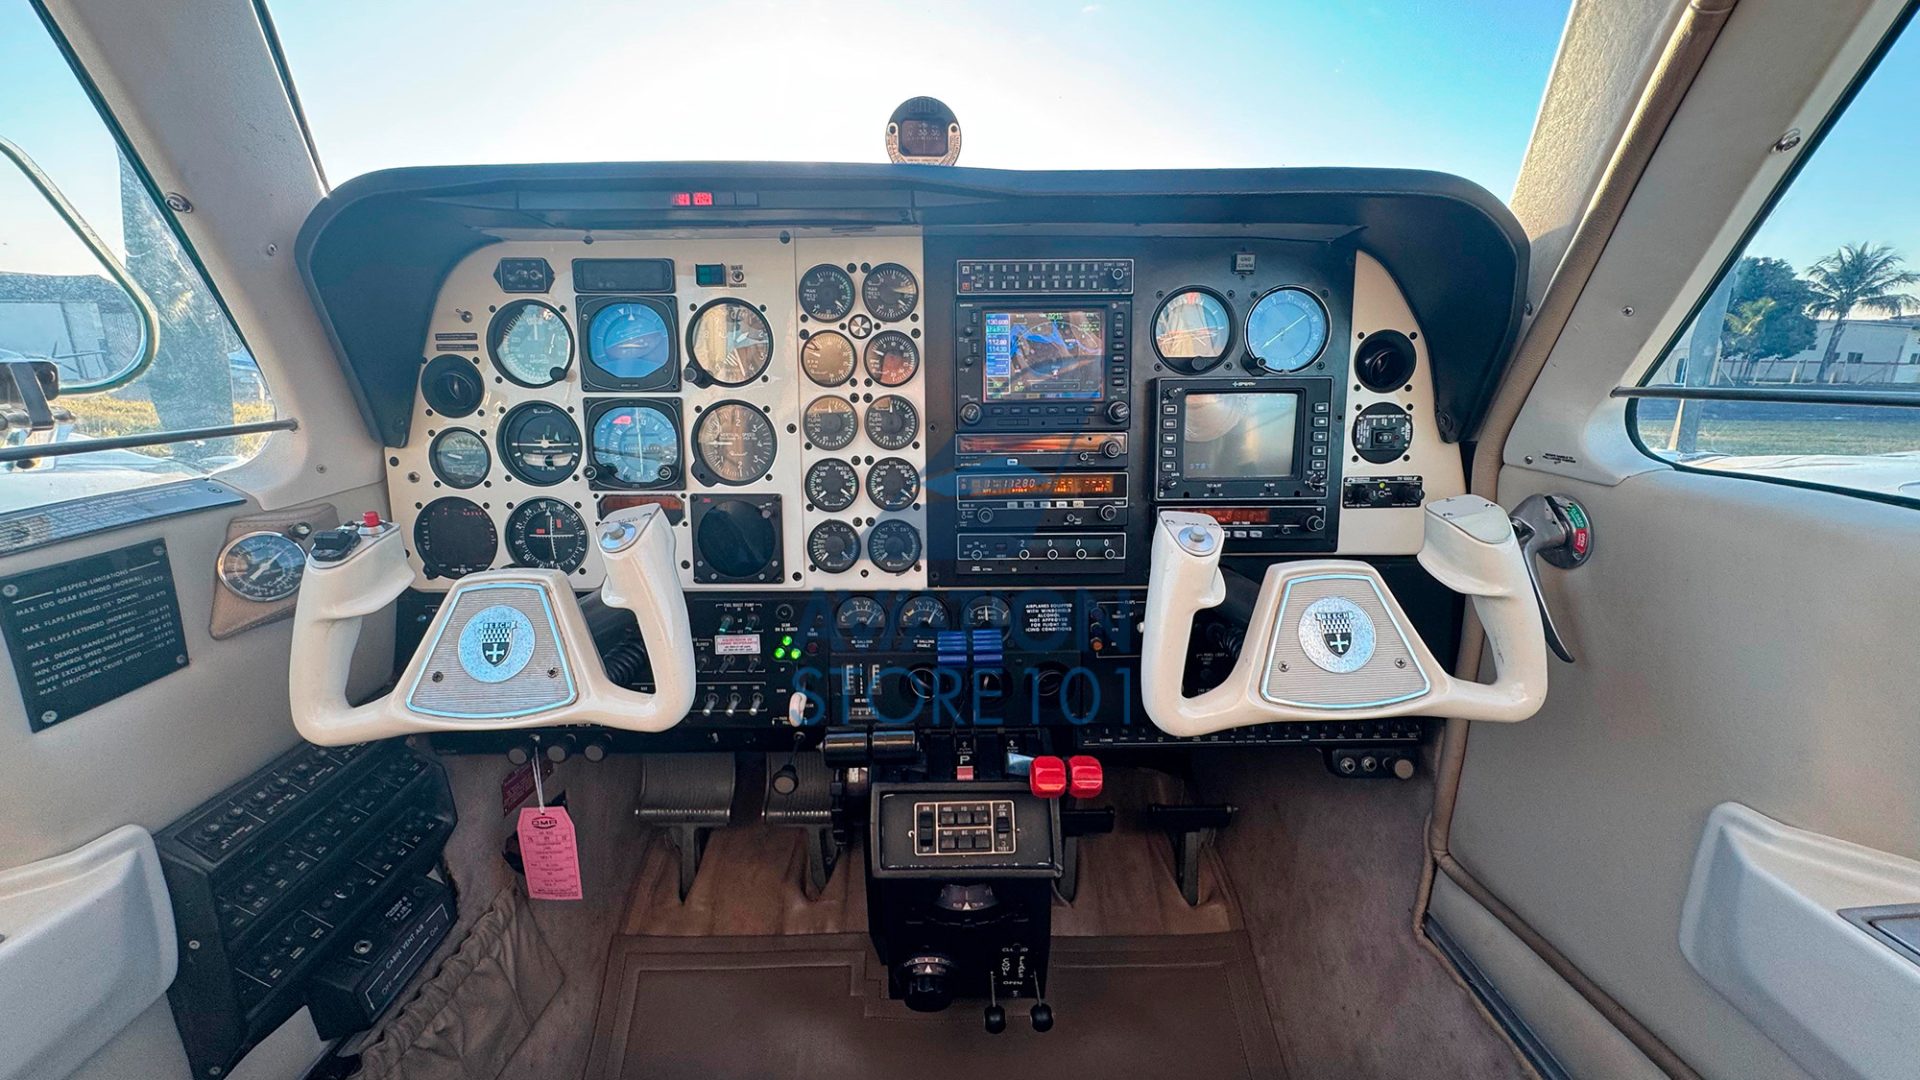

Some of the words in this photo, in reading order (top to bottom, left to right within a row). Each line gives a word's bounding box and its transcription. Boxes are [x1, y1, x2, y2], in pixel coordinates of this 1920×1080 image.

[56, 578, 88, 594] AIRSPEED
[90, 569, 129, 584] LIMITATIONS
[80, 584, 111, 598] EXTENDED
[44, 615, 65, 626] FLAPS
[67, 605, 100, 620] EXTENDED
[50, 633, 70, 643] FLAPS
[72, 621, 104, 635] EXTENDED
[960, 755, 970, 764] P
[430, 926, 439, 936] ON
[386, 949, 402, 969] CABIN
[402, 933, 416, 950] VENT
[416, 924, 424, 935] AIR
